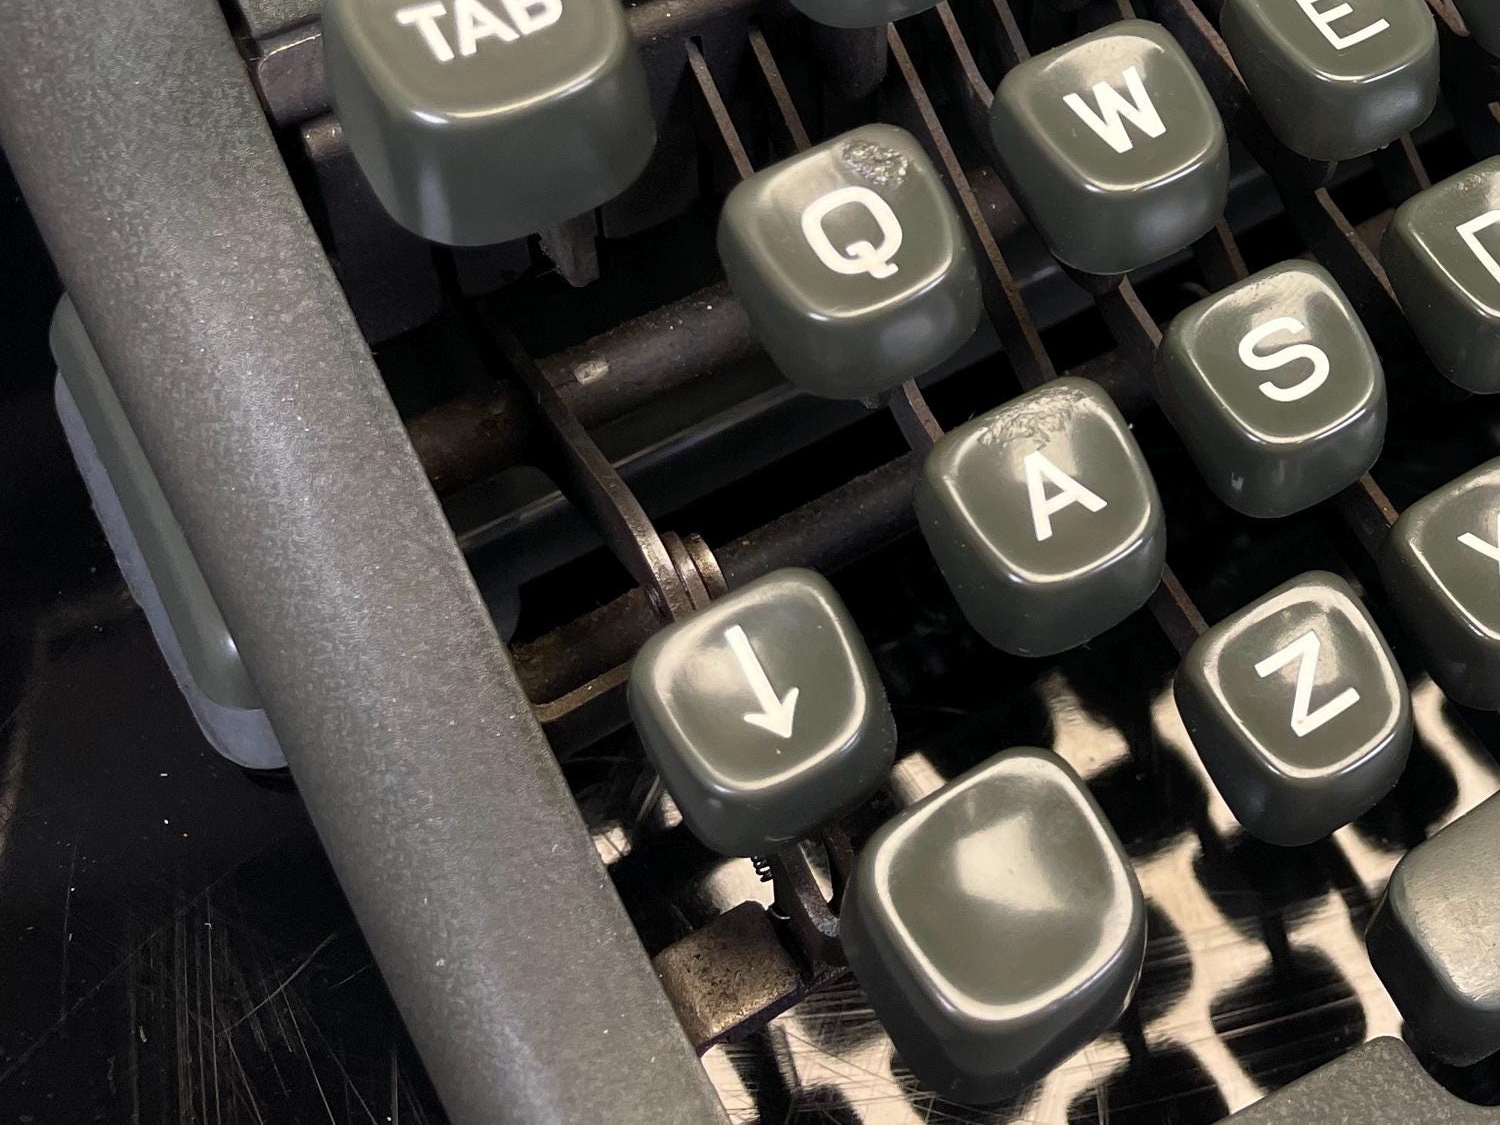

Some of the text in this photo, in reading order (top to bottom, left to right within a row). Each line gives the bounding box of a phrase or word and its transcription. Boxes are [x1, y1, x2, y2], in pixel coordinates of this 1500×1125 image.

[1062, 66, 1167, 154] W
[802, 186, 902, 278] Q
[1238, 317, 1330, 402] S
[1023, 450, 1108, 542] A
[1255, 631, 1359, 736] Z
